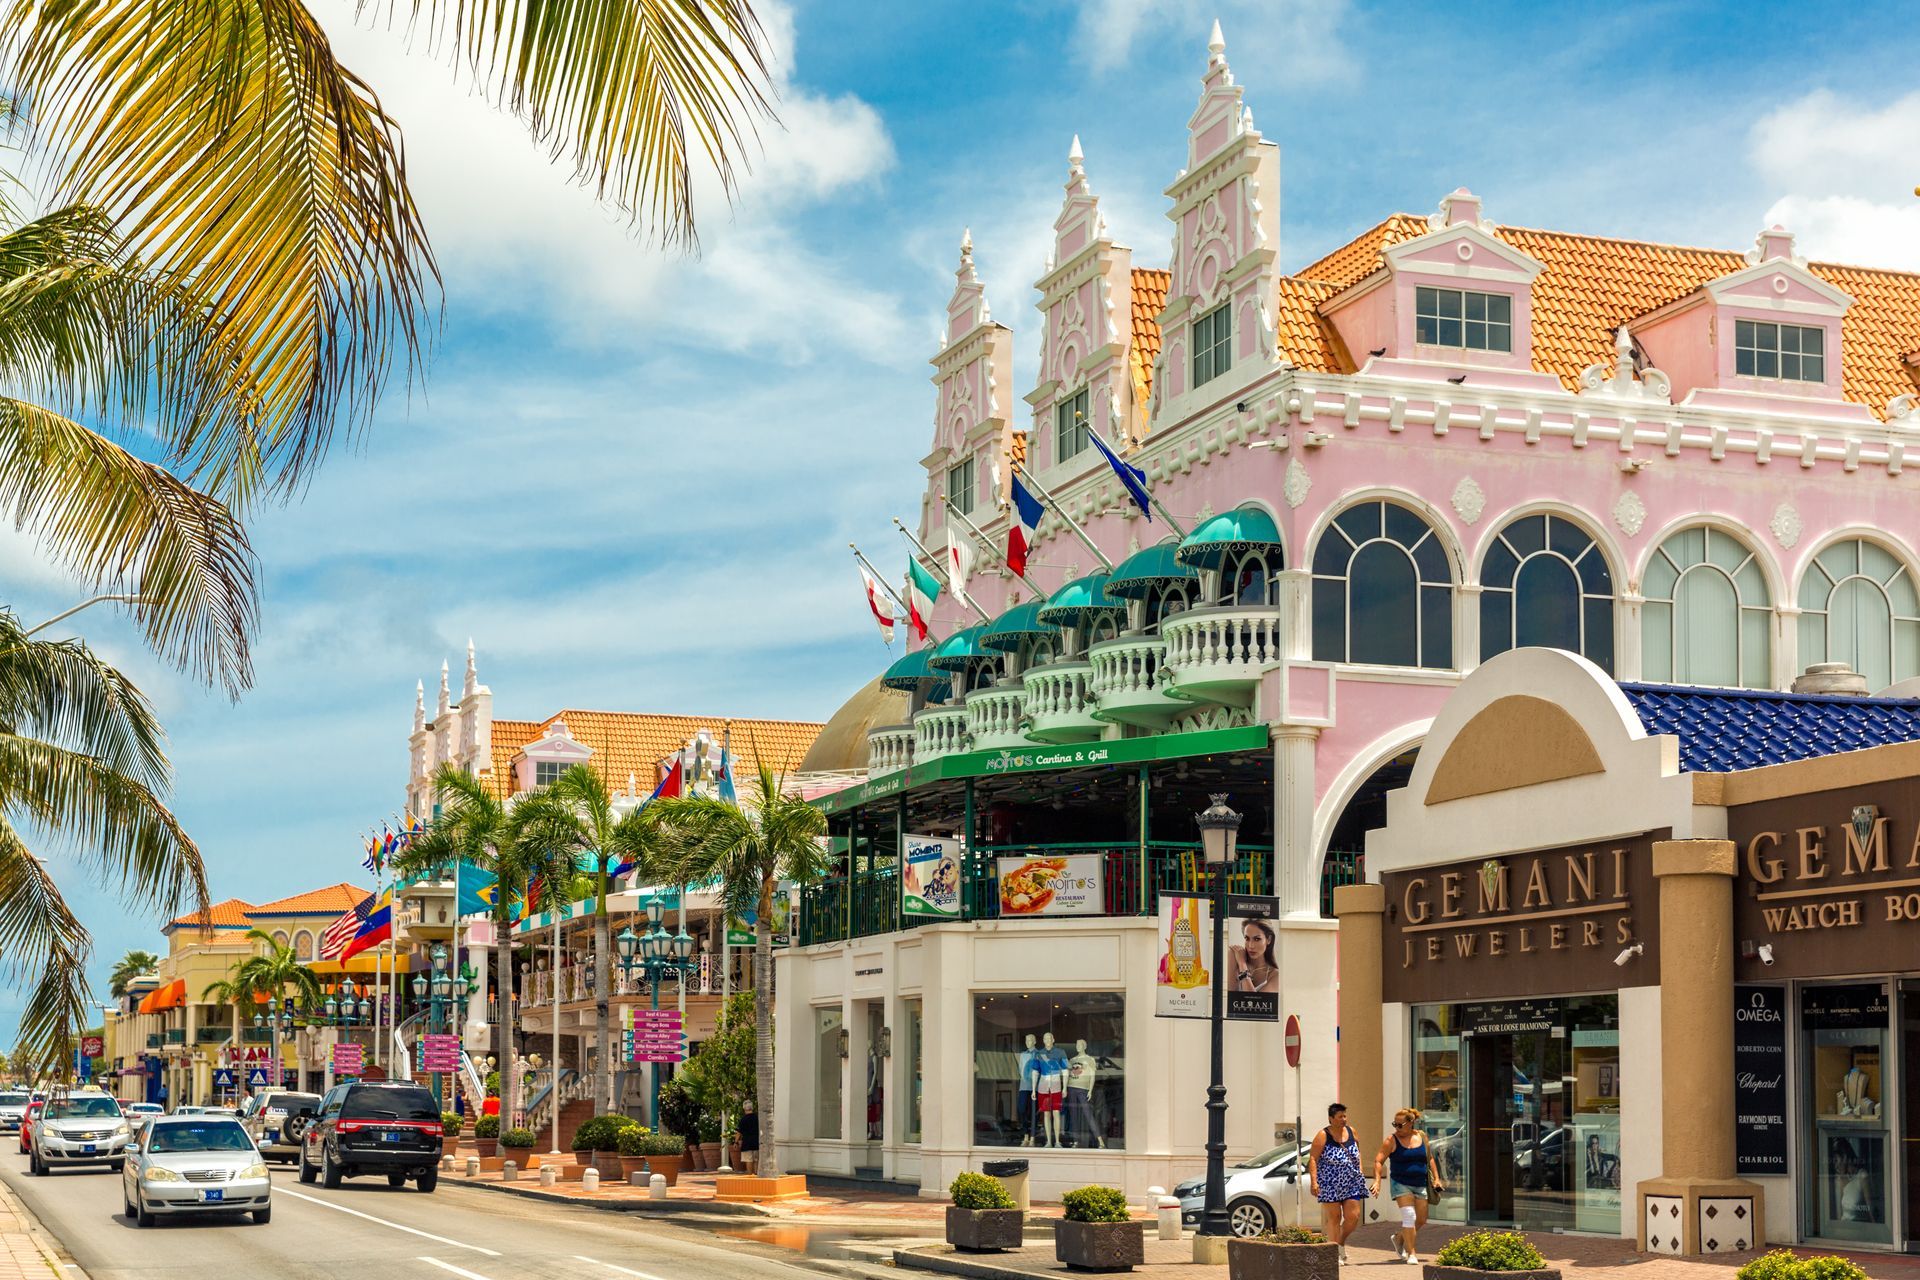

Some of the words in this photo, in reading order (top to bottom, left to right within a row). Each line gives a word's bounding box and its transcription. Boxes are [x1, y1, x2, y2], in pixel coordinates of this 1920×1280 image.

[1035, 753, 1072, 765] Cantina
[1075, 751, 1084, 761] &
[1088, 749, 1108, 763] Grill
[909, 843, 943, 857] MOMENTS
[1046, 877, 1097, 896] MOJITO'S
[1404, 850, 1630, 925] GEMANI
[1762, 900, 1862, 933] WATCH
[1403, 917, 1632, 969] JEWELERS
[1736, 1008, 1781, 1022] OMEGA
[1489, 1024, 1500, 1032] FOR
[1500, 1022, 1519, 1032] LOOSE
[1737, 1045, 1765, 1053] ROBERTO
[1736, 1072, 1782, 1093] Chopard
[1738, 1115, 1767, 1124] RAYMOND
[1767, 1115, 1783, 1124] WEIL
[1738, 1155, 1784, 1163] CHARRIOL
